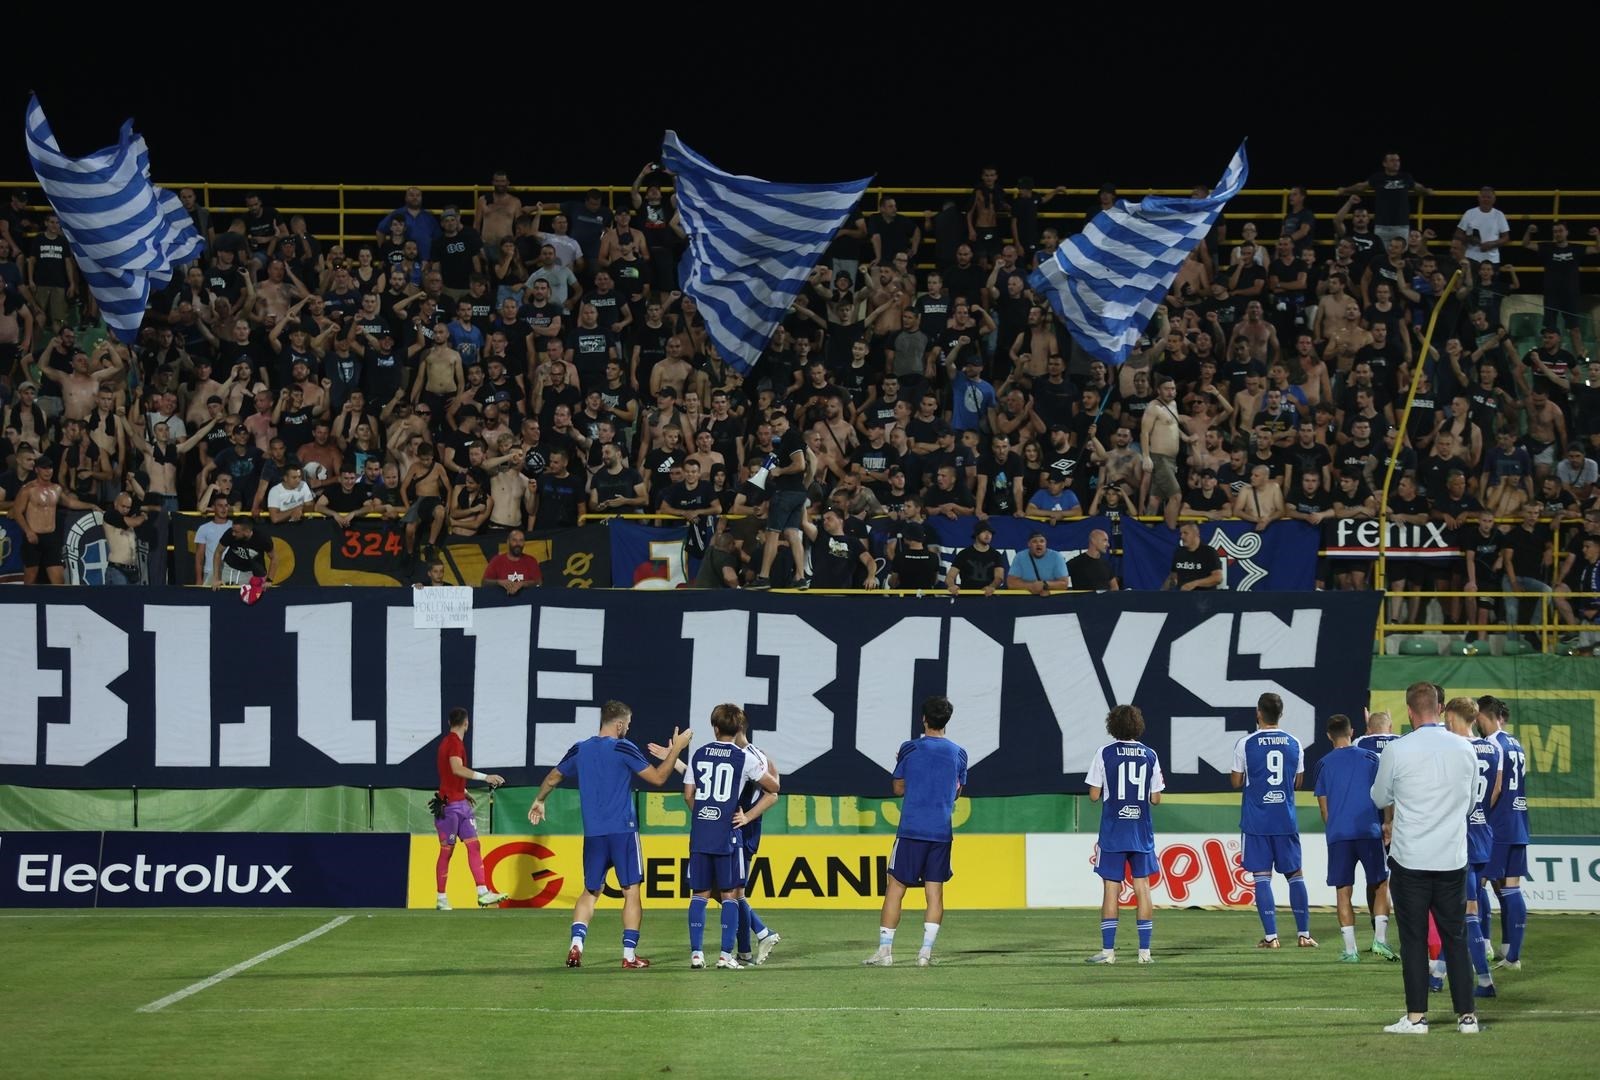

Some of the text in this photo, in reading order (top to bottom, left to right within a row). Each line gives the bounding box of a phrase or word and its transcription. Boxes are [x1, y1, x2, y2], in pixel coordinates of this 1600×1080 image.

[341, 530, 403, 559] 324
[0, 602, 1323, 775] BLUE BOYS
[694, 761, 735, 803] 30
[1117, 761, 1148, 801] 14
[1266, 749, 1283, 786] 9
[17, 853, 293, 893] Electrolux
